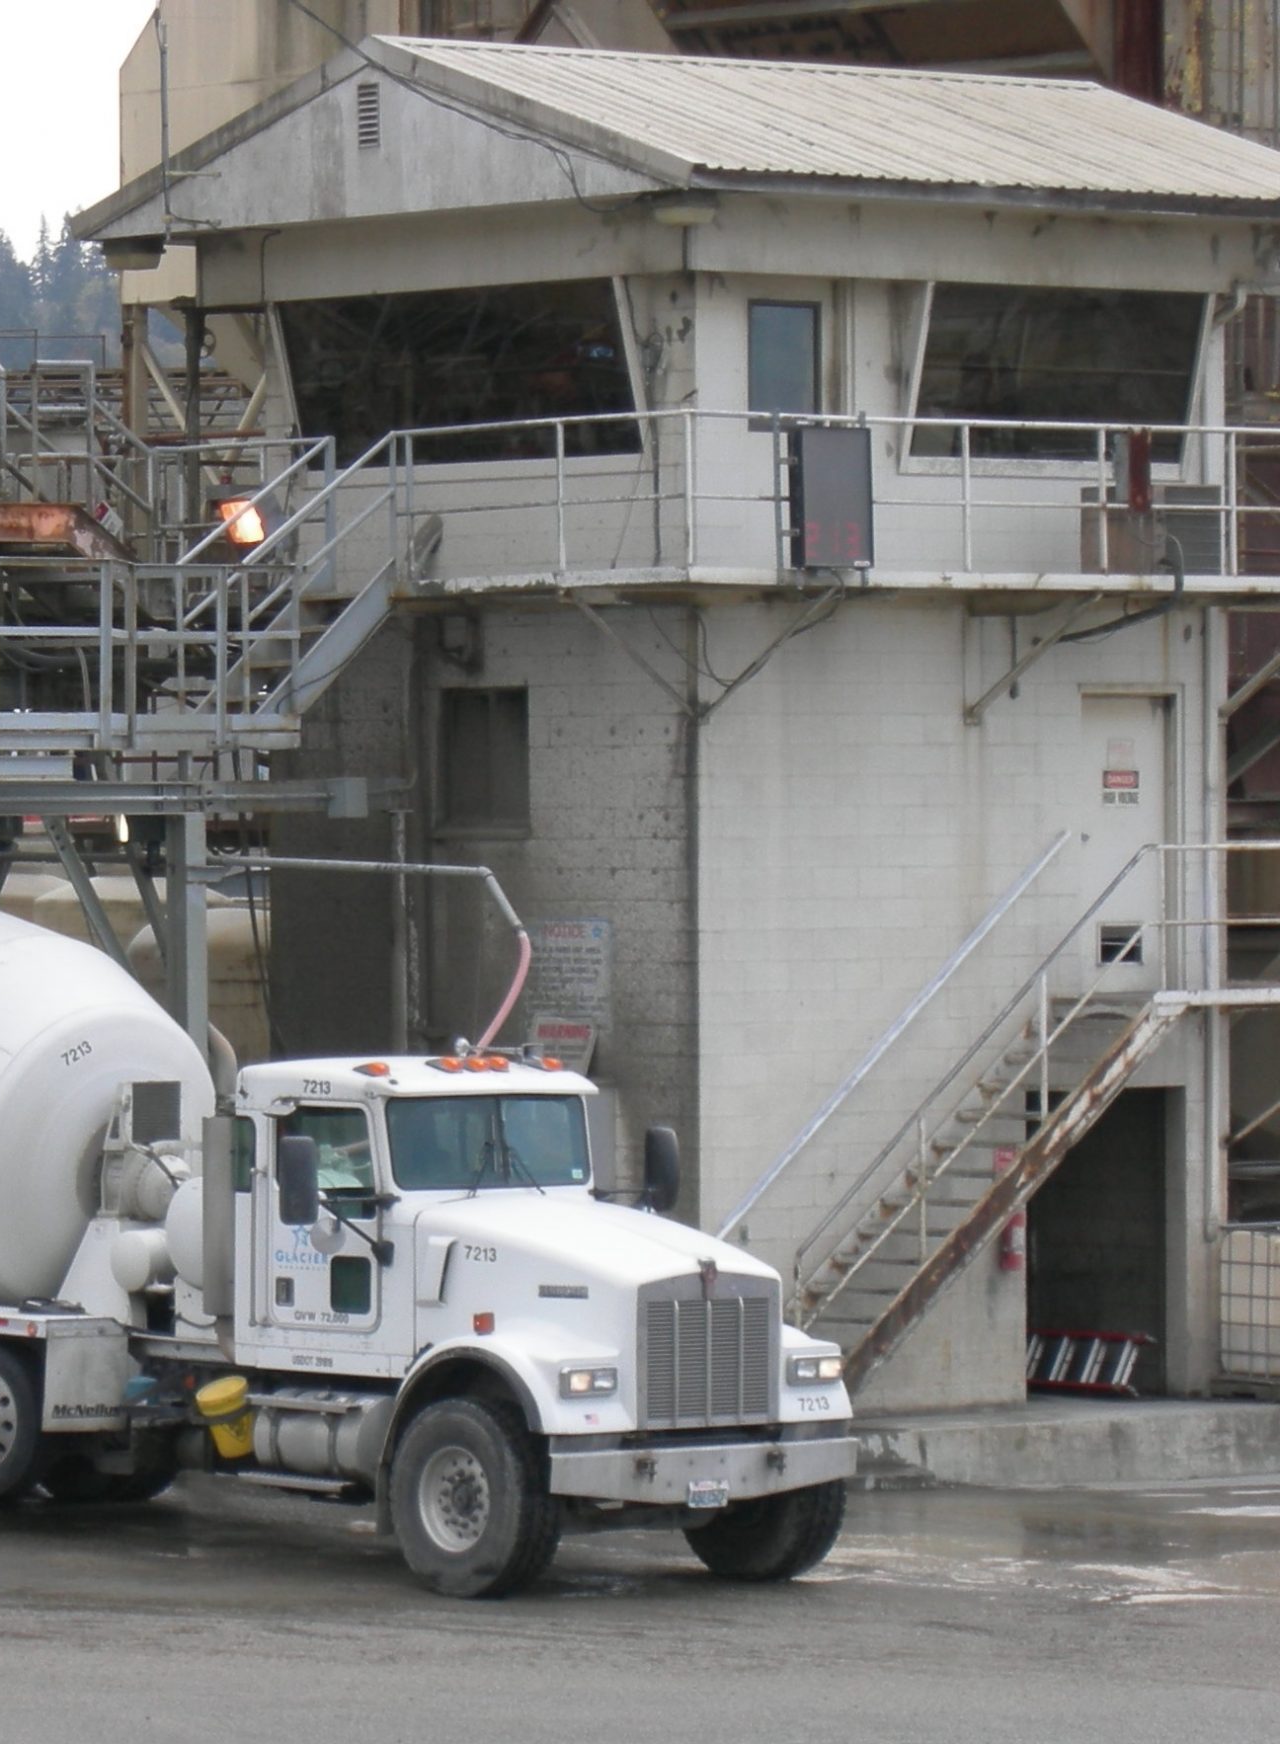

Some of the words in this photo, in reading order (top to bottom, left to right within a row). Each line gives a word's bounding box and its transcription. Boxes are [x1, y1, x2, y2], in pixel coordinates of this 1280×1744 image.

[60, 1040, 92, 1066] 7213
[303, 1079, 331, 1095] 7213
[274, 1249, 328, 1265] GLACIER
[464, 1245, 498, 1262] 7213
[797, 1395, 830, 1412] 7213
